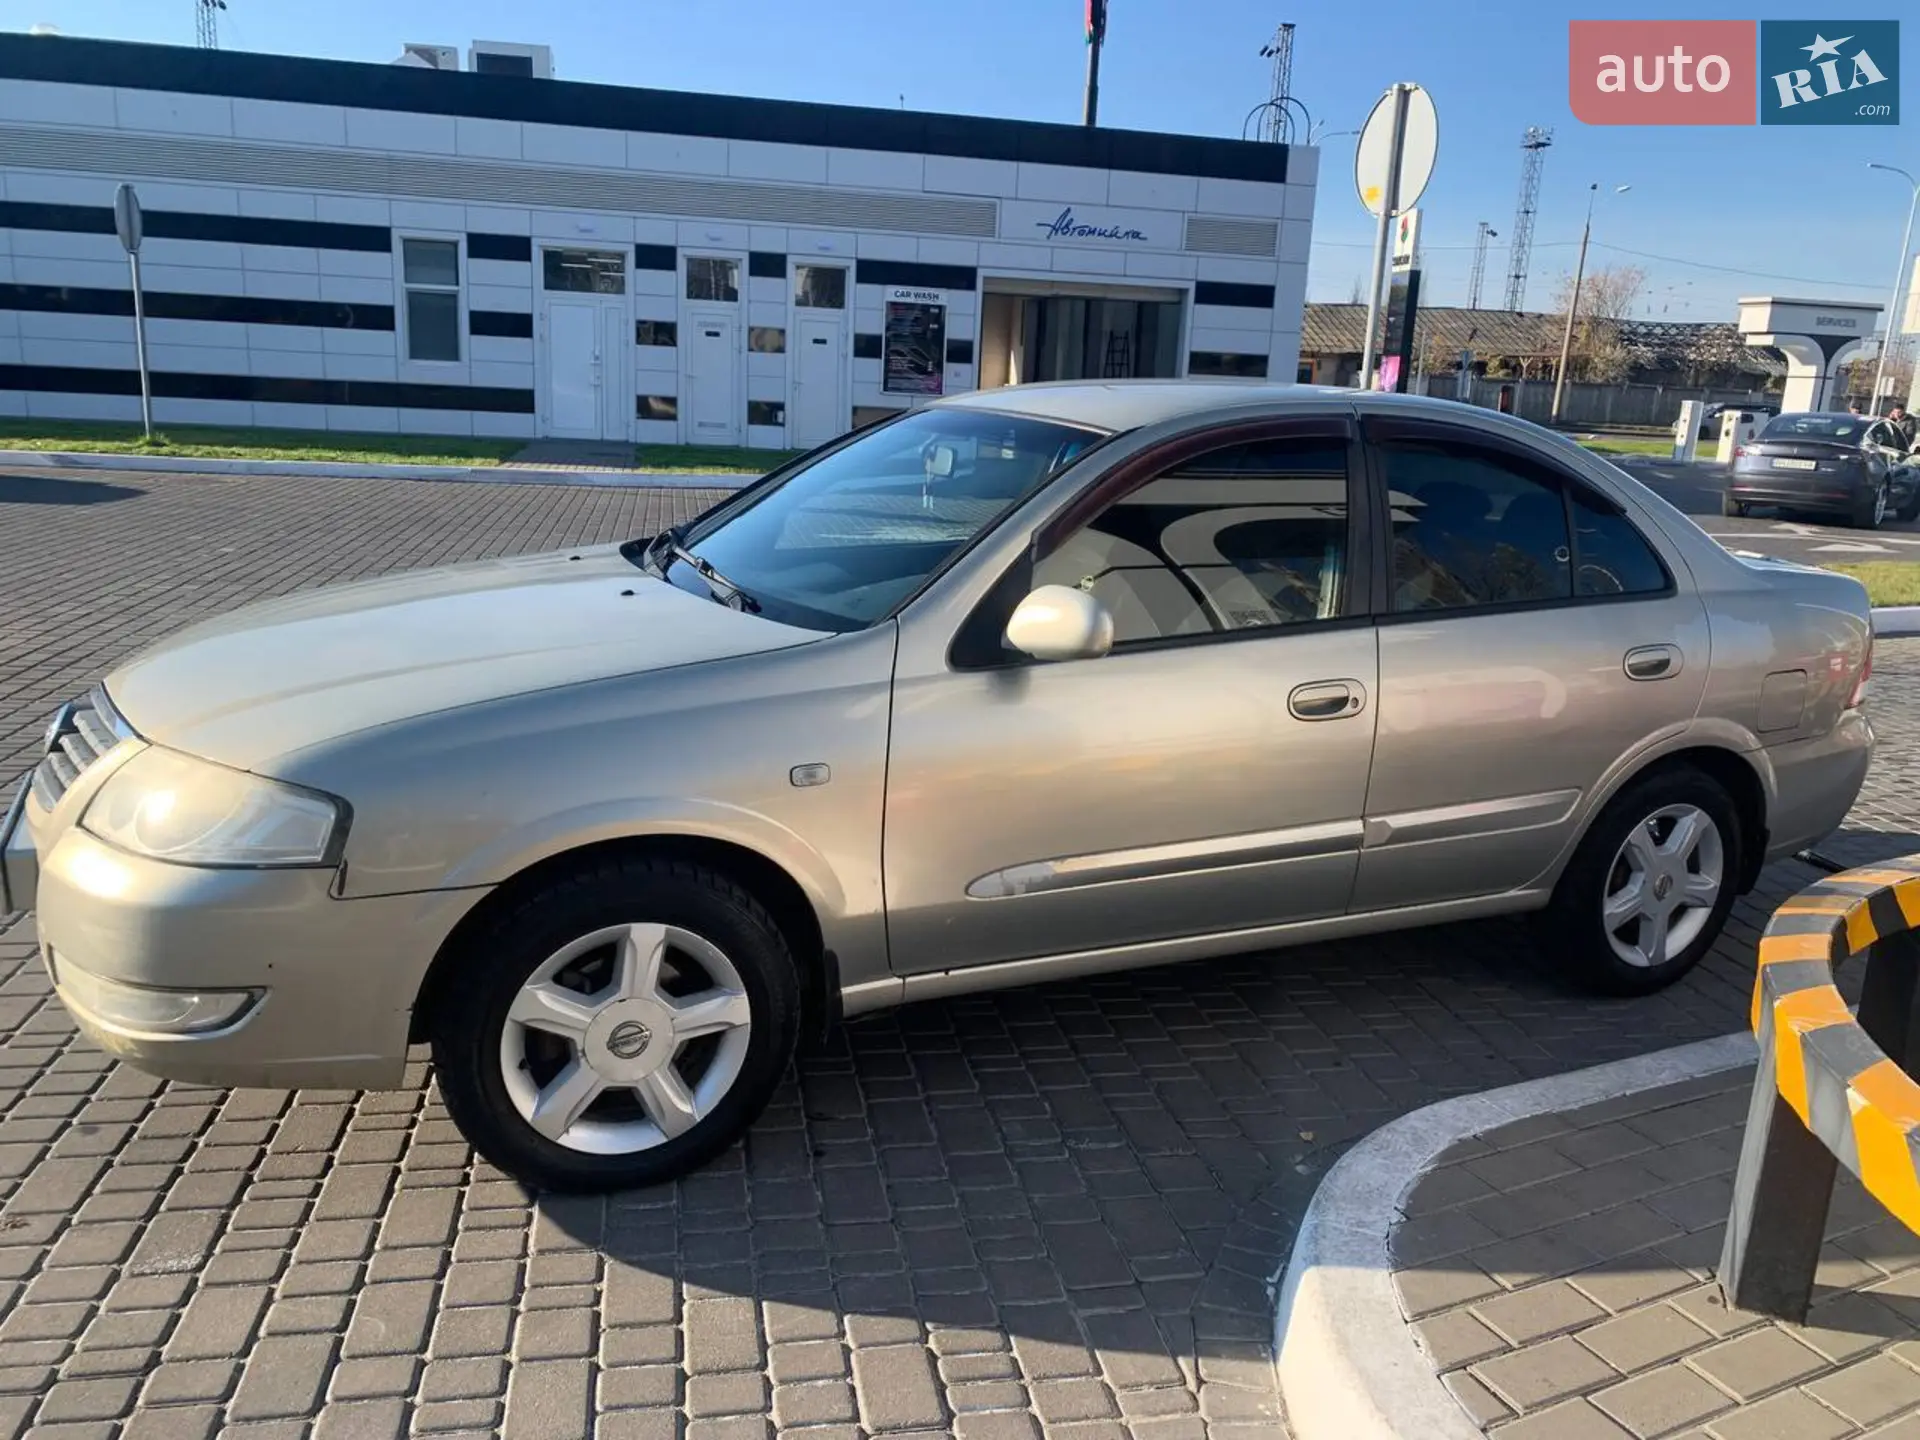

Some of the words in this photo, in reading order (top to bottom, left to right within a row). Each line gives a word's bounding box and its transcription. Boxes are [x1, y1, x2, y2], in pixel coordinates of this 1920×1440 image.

[894, 290, 912, 298] CAR
[914, 291, 940, 301] WASH
[1815, 316, 1856, 328] SERVICES
